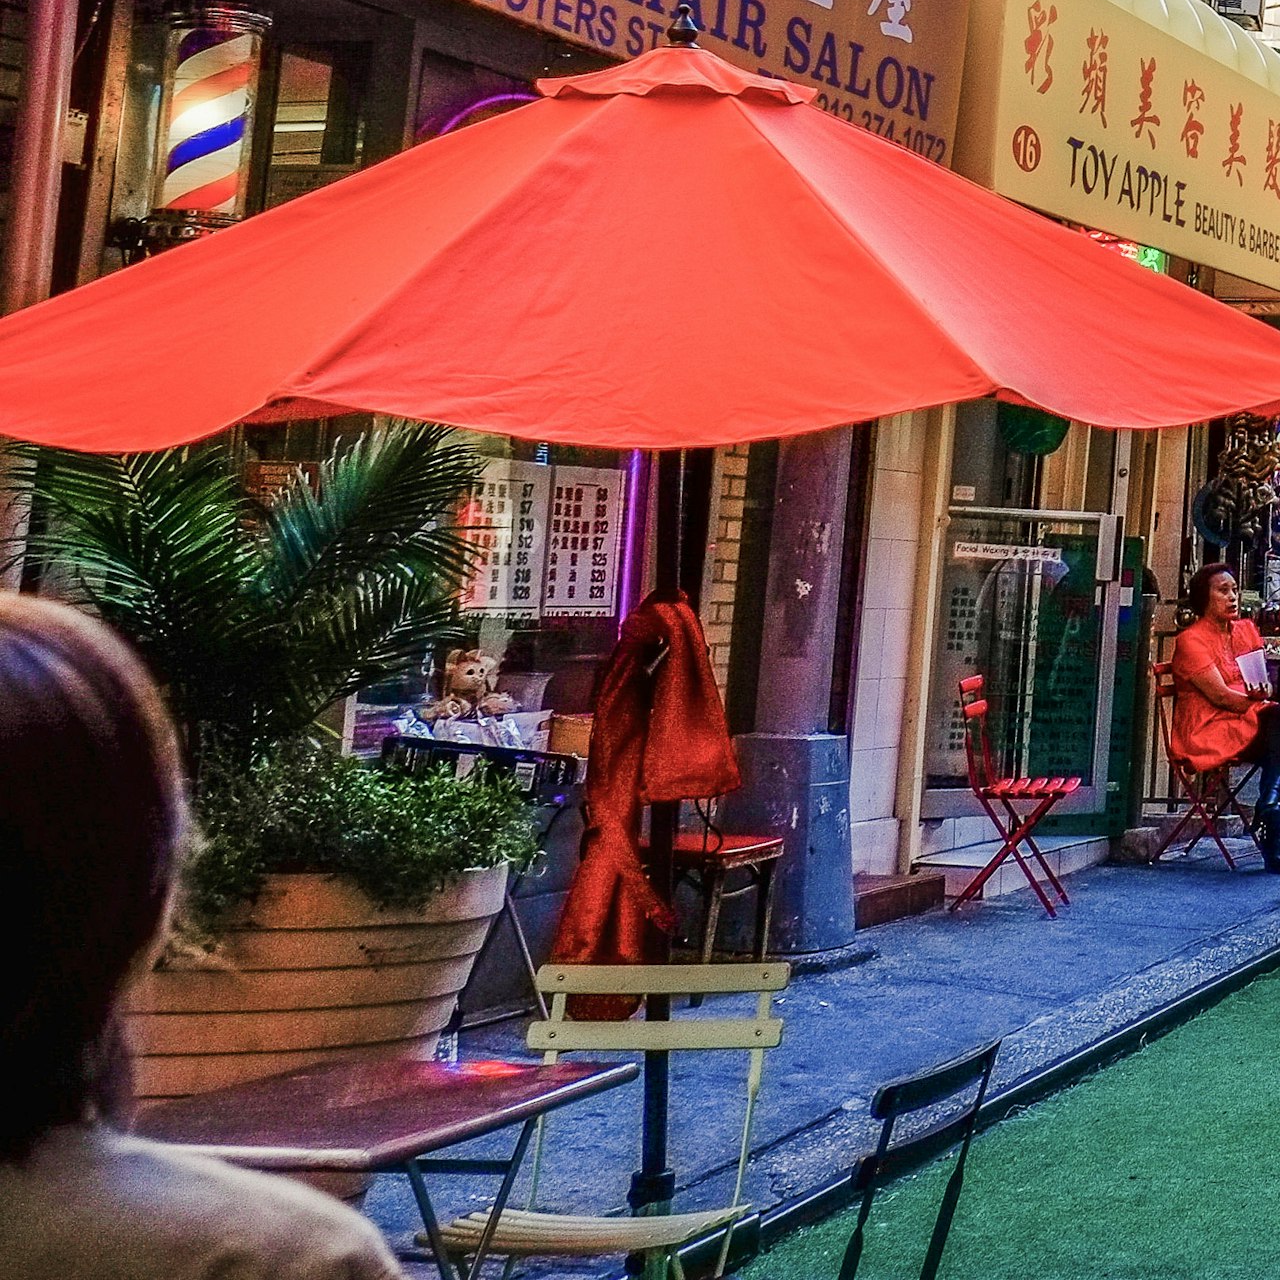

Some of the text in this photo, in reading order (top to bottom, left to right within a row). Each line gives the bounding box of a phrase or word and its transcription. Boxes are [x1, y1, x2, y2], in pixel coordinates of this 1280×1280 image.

[784, 17, 935, 121] SALON
[1016, 131, 1039, 167] 16
[1067, 136, 1117, 201] TOY
[1119, 165, 1186, 228] APPLE
[1194, 202, 1237, 251] BEAUTY
[1237, 225, 1248, 249] &
[956, 544, 978, 554] Facial
